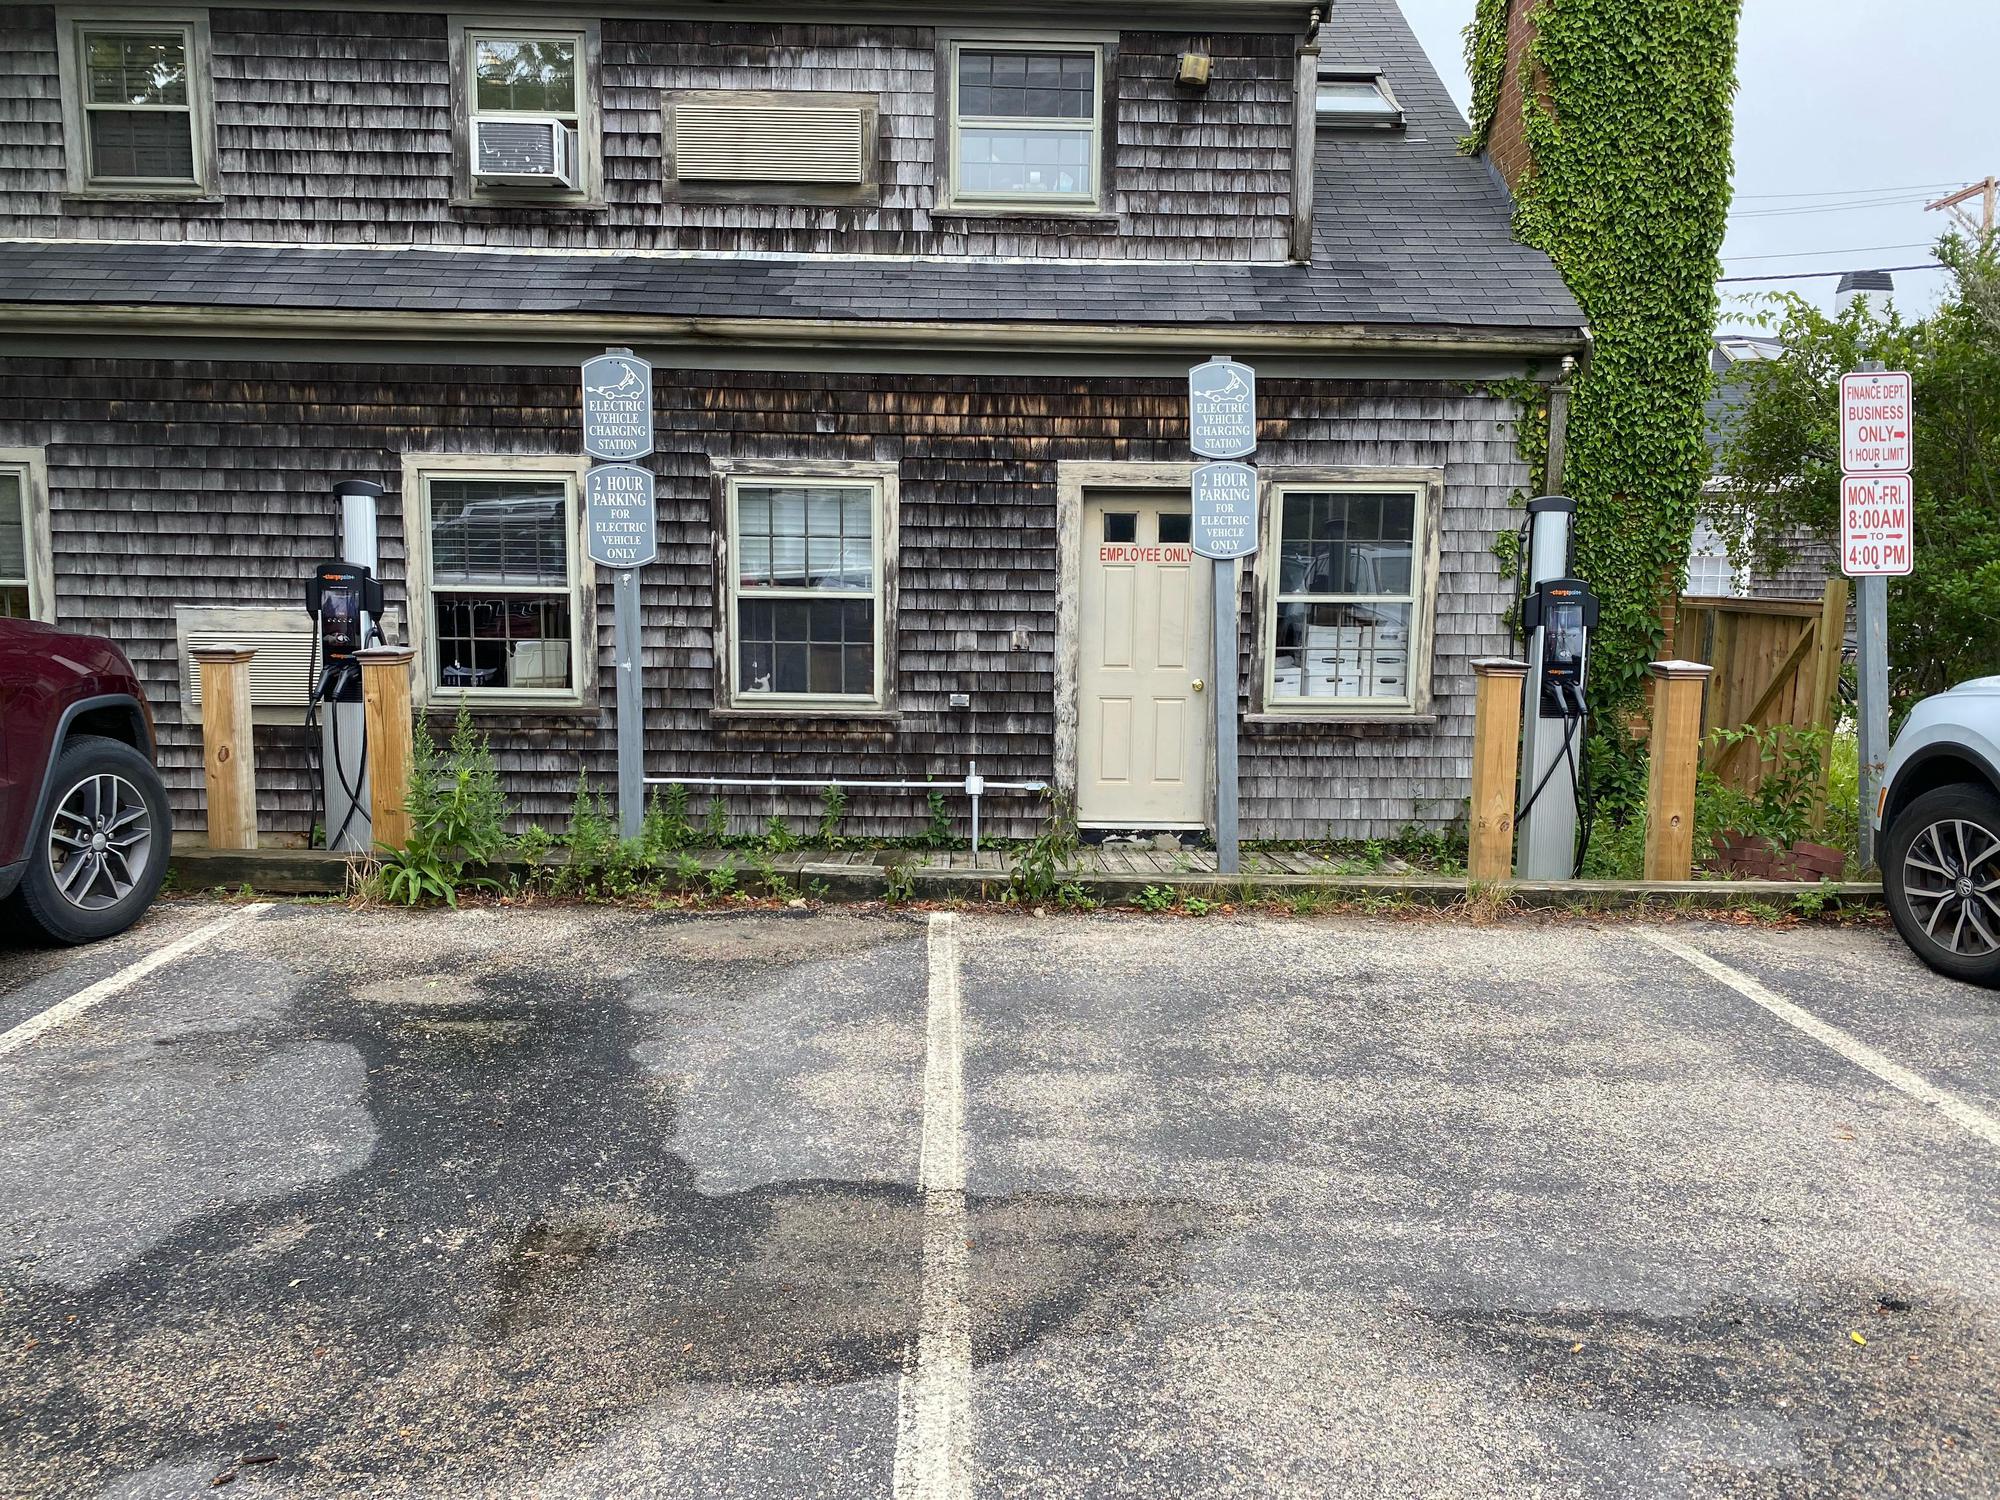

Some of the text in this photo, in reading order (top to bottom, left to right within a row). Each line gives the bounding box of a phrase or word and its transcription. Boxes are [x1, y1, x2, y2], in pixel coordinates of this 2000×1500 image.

[1847, 384, 1905, 400] FINANCE DEPT.
[589, 401, 645, 412] ELECTRIC
[1197, 403, 1250, 413] ELECTRIC
[596, 413, 639, 424] VEHICLE
[1849, 406, 1904, 420] BUSINESS
[1202, 414, 1243, 424] VEHICLE
[589, 426, 646, 436] CHARGING
[1196, 425, 1250, 436] CHARGING
[1858, 425, 1894, 443] ONLY
[598, 439, 637, 450] STATION
[1205, 438, 1242, 449] STATION
[1849, 447, 1904, 462] 1 HOUR LIMIT
[595, 476, 643, 491] 2 HOUR
[1201, 473, 1248, 487] 2 HOUR
[593, 493, 647, 506] PARKING
[1200, 488, 1250, 501] PARKING
[1848, 485, 1904, 505] MON.-FRI.
[1216, 503, 1234, 513] FOR
[611, 509, 630, 519] FOR
[1849, 509, 1905, 529] 8:00AM
[1201, 515, 1250, 525] ELECTRIC
[596, 522, 647, 533] ELECTRIC
[1207, 528, 1245, 537] VEHICLE
[602, 535, 641, 545] VEHICLE
[1870, 532, 1884, 541] TO
[1211, 540, 1240, 550] ONLY
[607, 548, 637, 559] ONLY
[1100, 547, 1193, 562] EMPLOYEE ONLY
[1849, 545, 1905, 565] 4:00 PM
